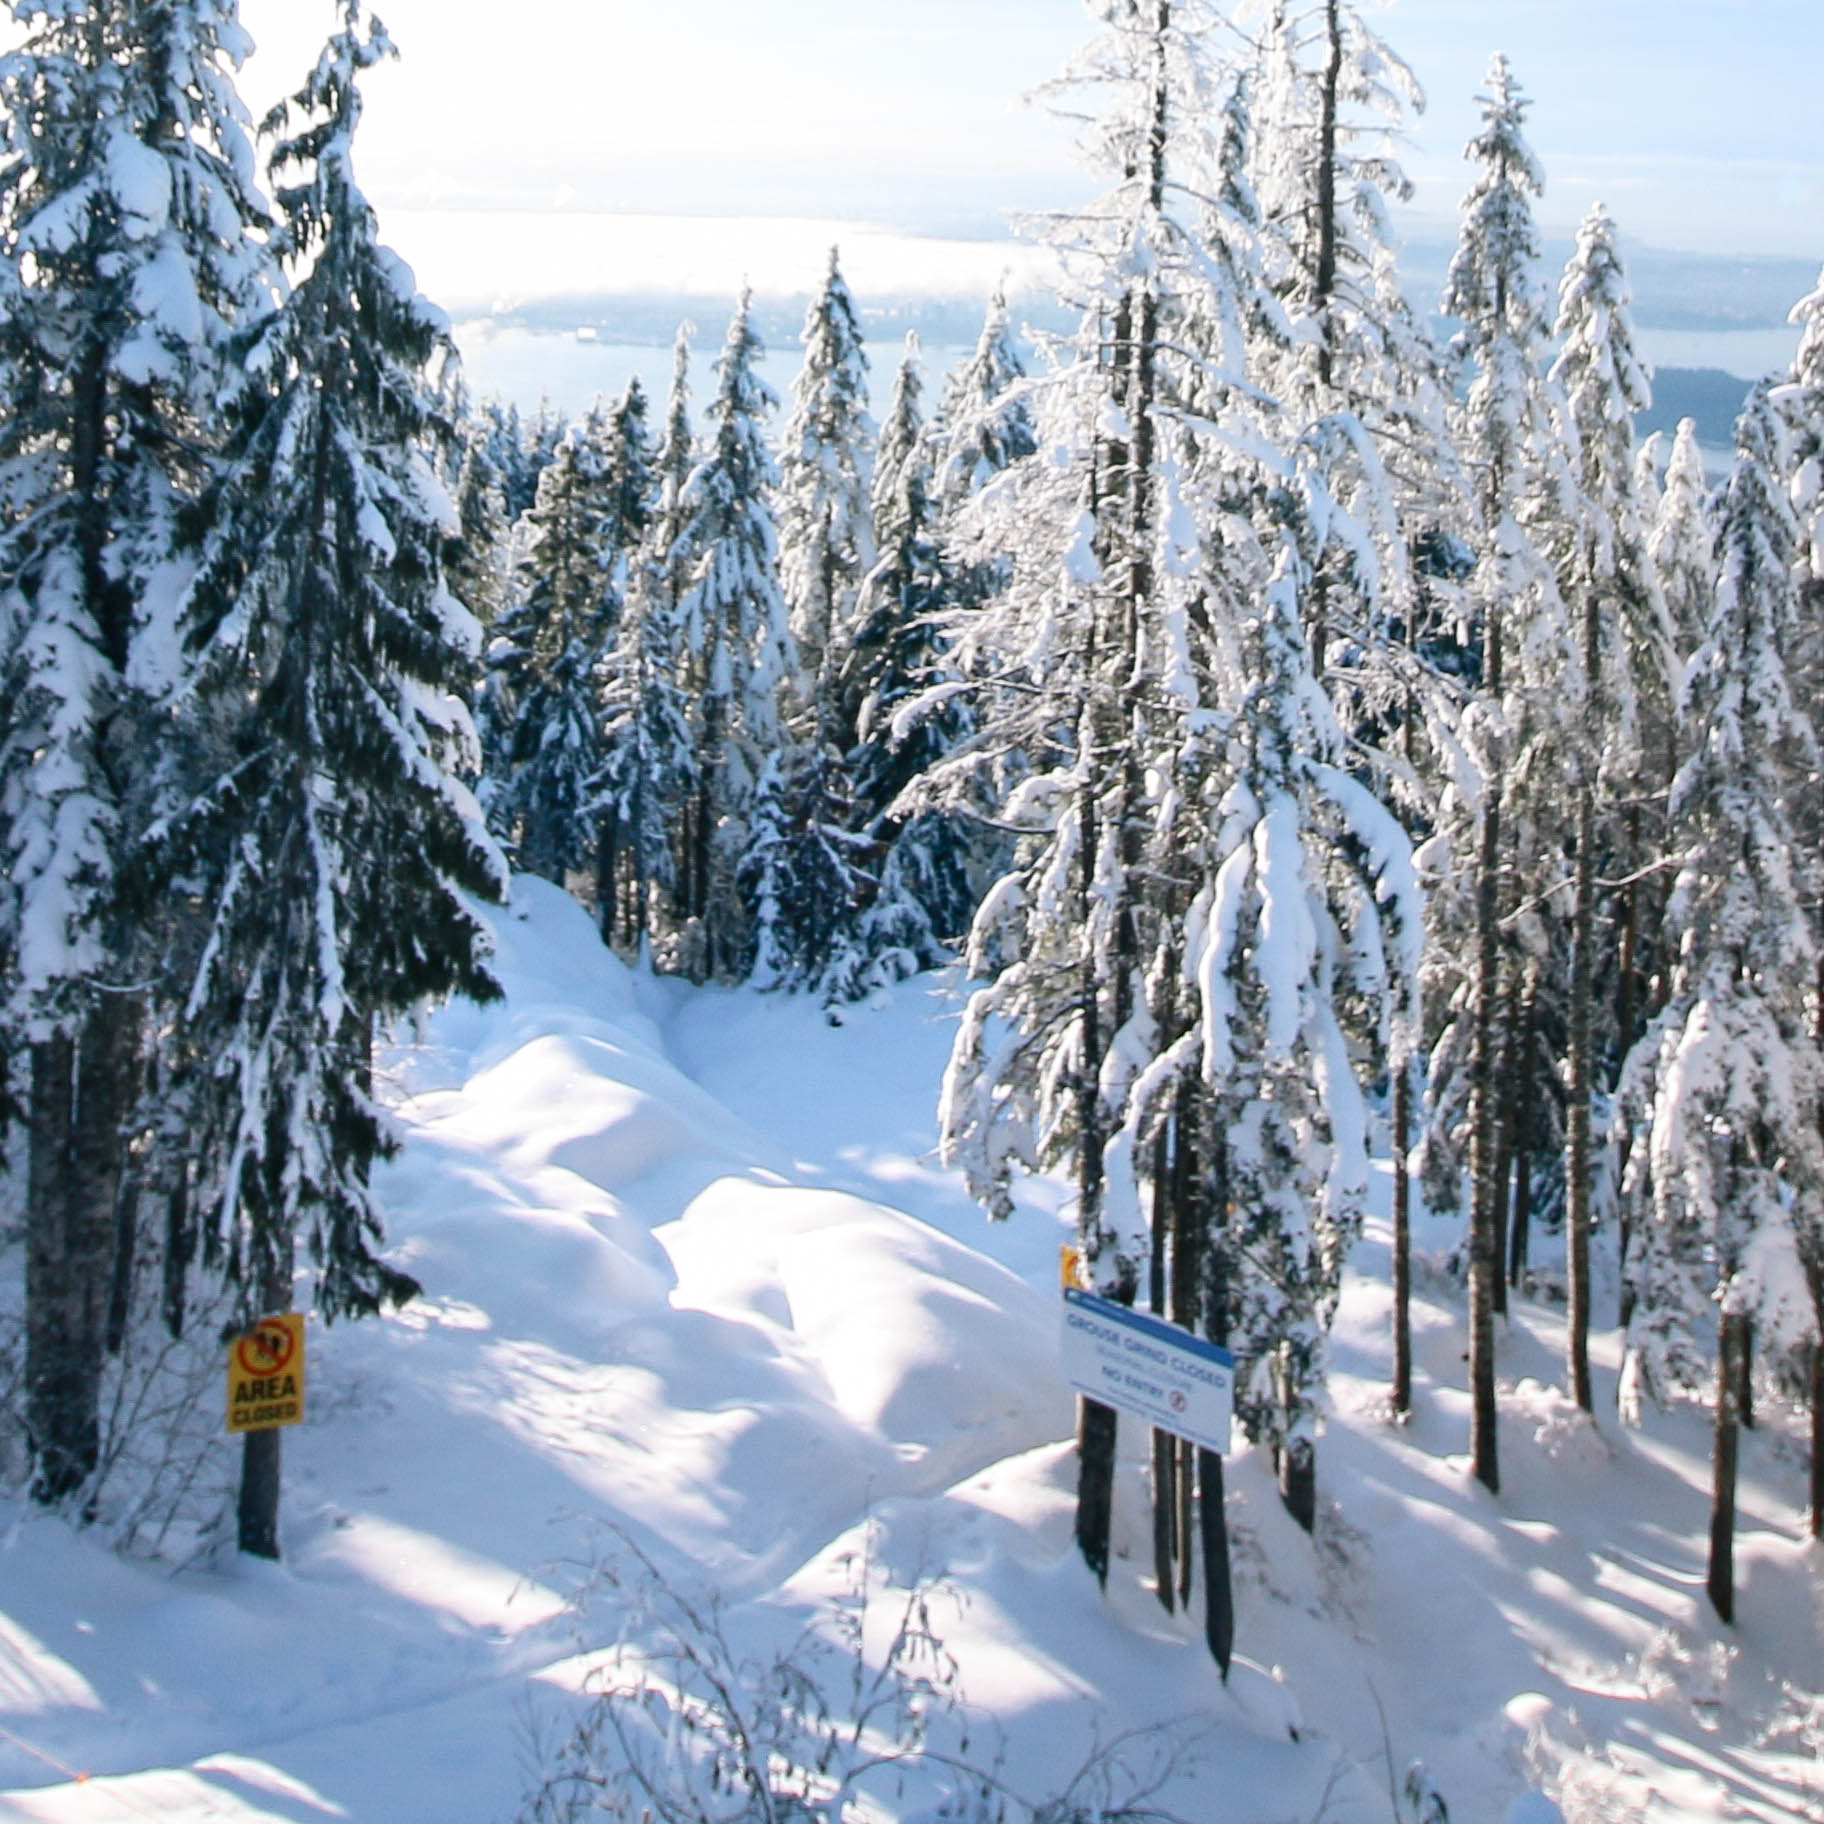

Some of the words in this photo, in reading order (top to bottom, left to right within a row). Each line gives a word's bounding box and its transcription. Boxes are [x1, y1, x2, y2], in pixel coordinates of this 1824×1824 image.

[1066, 1312, 1120, 1347] GROUSE
[1123, 1337, 1168, 1365] GRIND
[1170, 1357, 1225, 1389] CLOSED
[235, 1374, 296, 1403] AREA
[1102, 1364, 1122, 1382] NO
[1124, 1374, 1164, 1399] ENTRY
[232, 1400, 298, 1427] CLOSED
